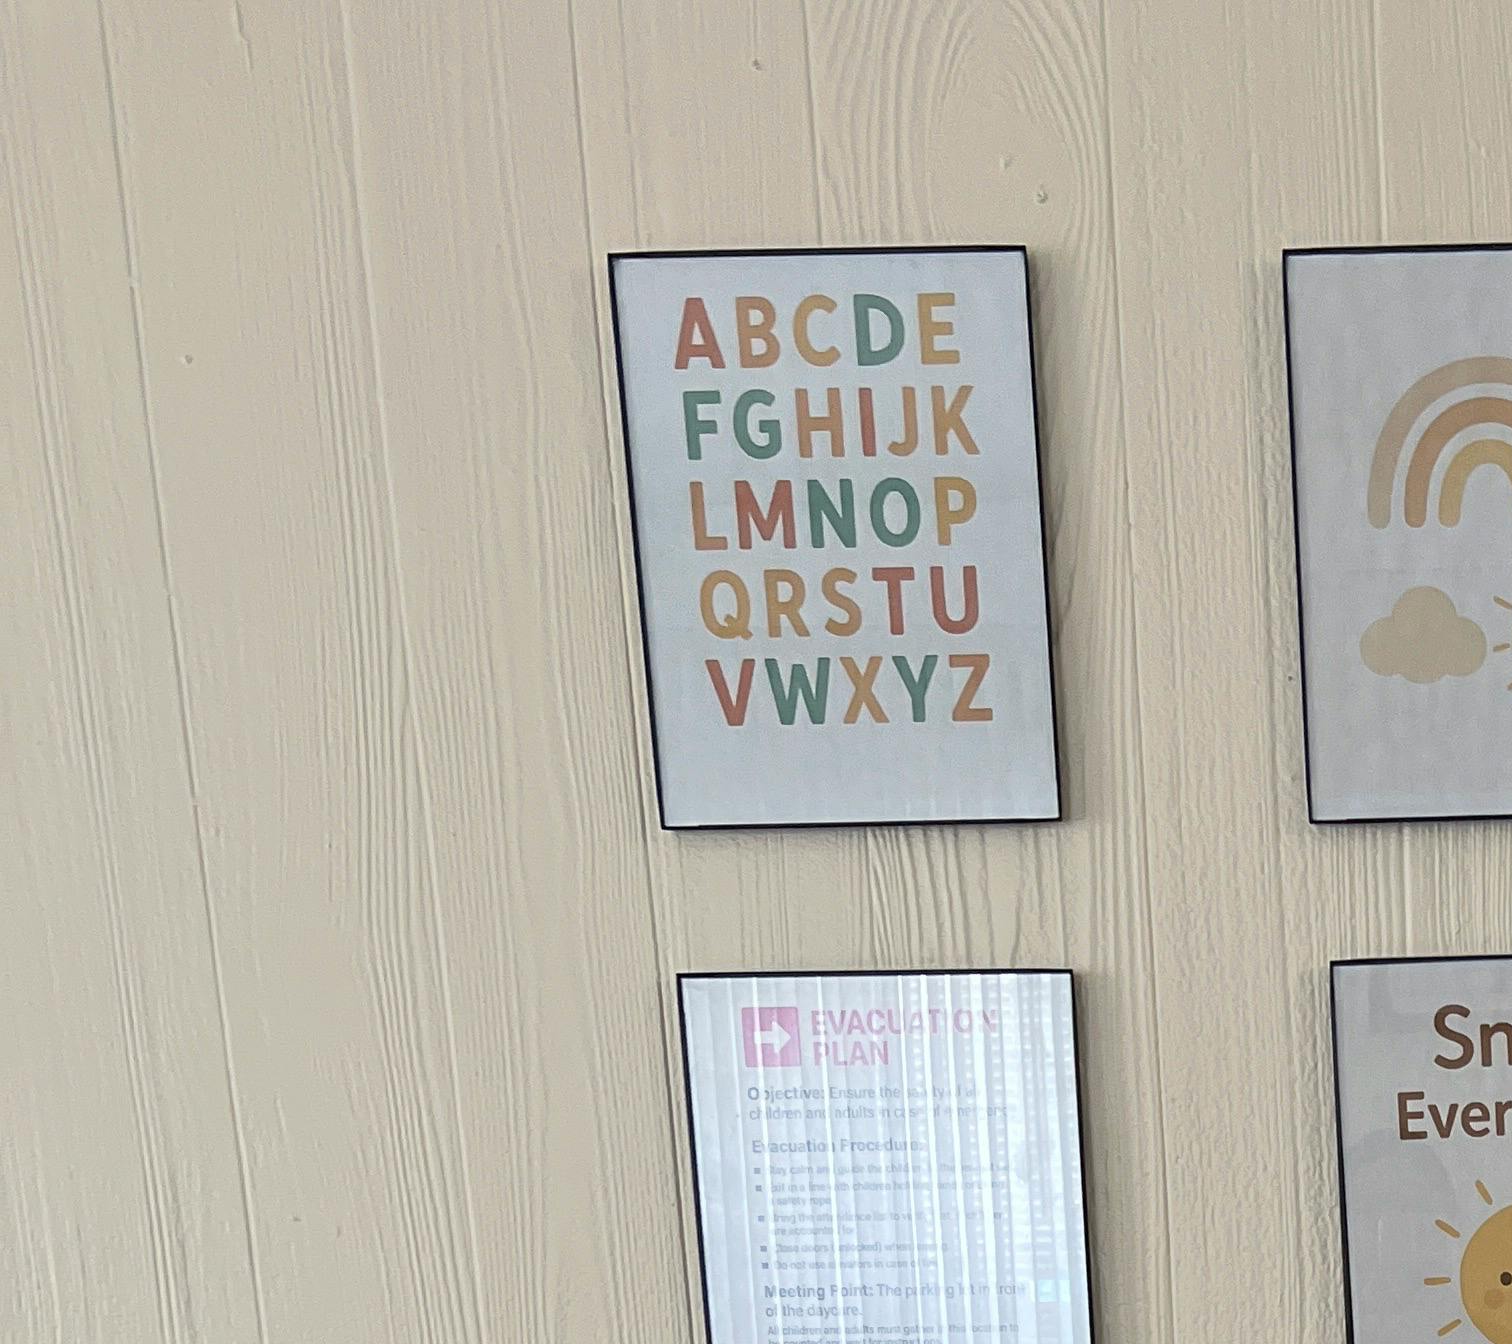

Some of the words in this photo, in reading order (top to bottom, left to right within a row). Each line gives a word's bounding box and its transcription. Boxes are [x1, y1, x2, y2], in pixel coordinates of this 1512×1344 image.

[674, 292, 960, 370] ABCDE
[682, 384, 980, 461] FGHIJK
[689, 475, 978, 551] LMNOP
[699, 565, 980, 640] QRSTU
[704, 653, 993, 727] VWXYZ
[811, 1008, 999, 1036] EVACUATON
[812, 1040, 890, 1066] PLAN
[829, 1086, 876, 1099] Ensure
[880, 1085, 900, 1099] the
[764, 1284, 825, 1301] Meeting
[877, 1283, 901, 1297] The
[783, 1304, 803, 1317] the
[807, 1303, 864, 1320] daycre.
